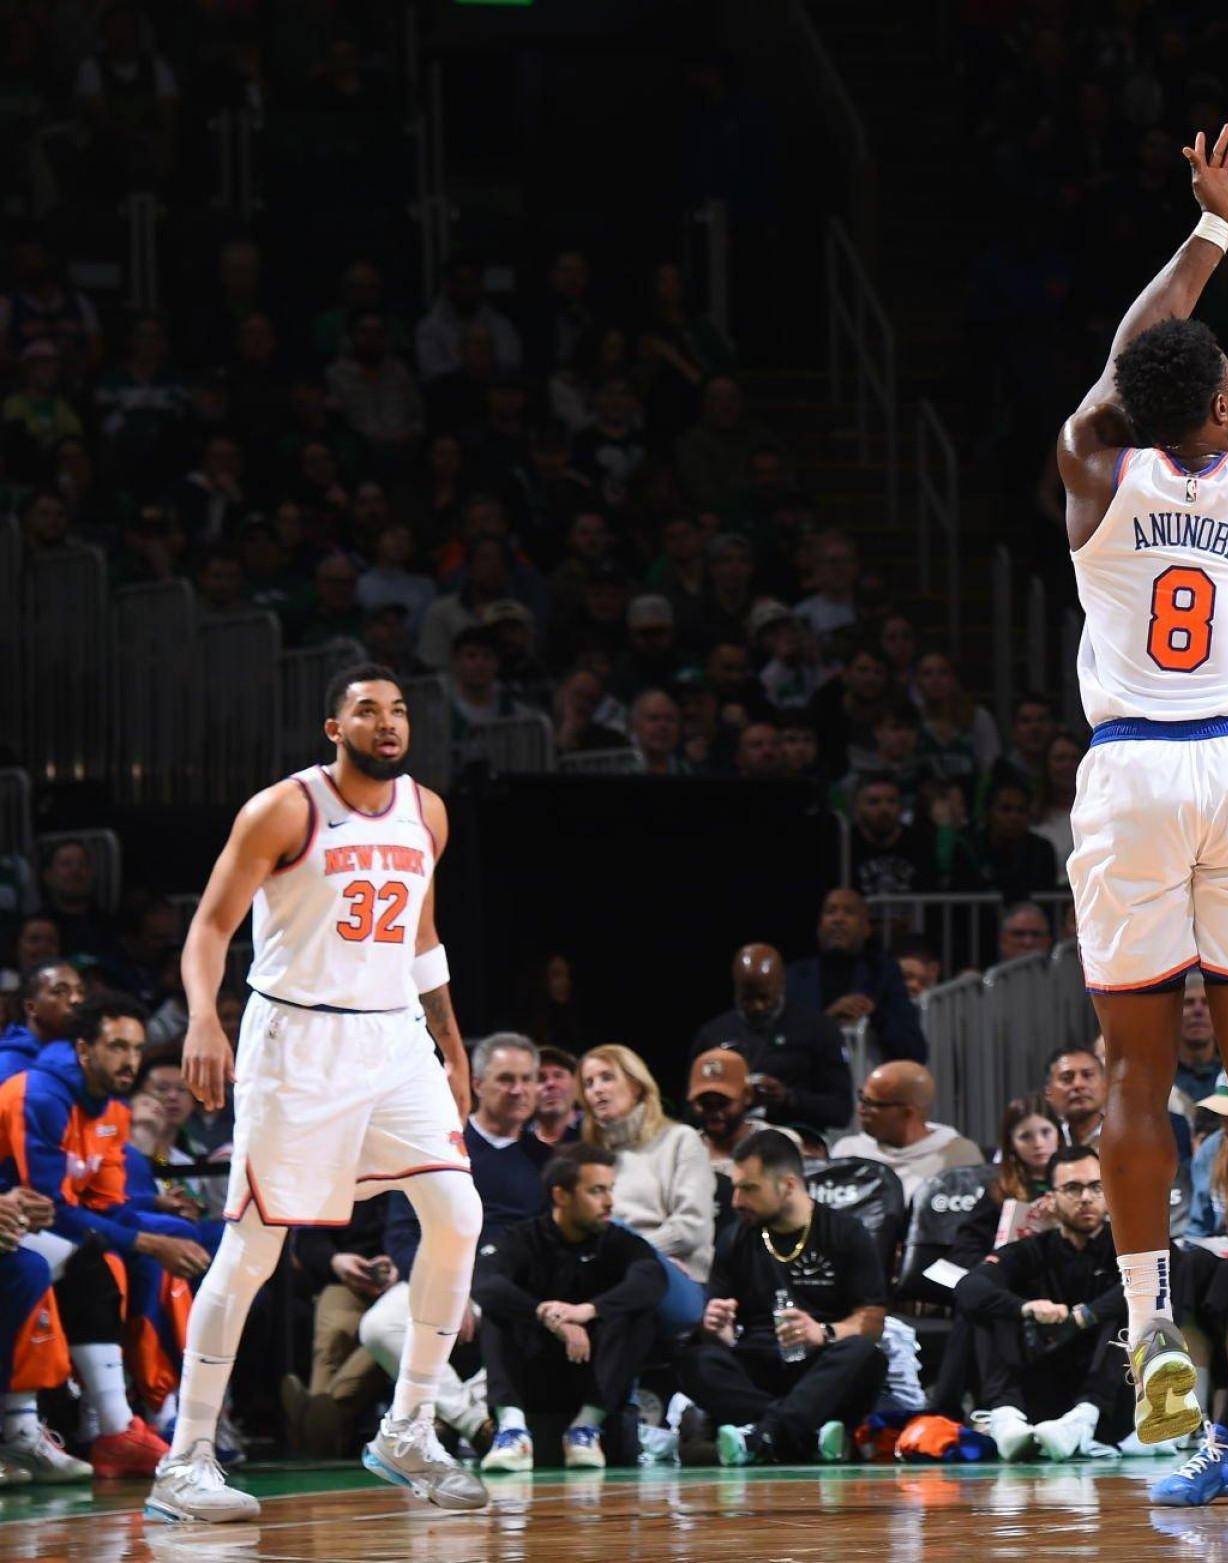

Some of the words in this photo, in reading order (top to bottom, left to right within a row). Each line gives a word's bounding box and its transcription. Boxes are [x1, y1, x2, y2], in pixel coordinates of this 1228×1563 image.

[1147, 565, 1217, 673] 8
[324, 845, 373, 876] NEW
[377, 845, 425, 877] YORK
[336, 880, 409, 944] 32
